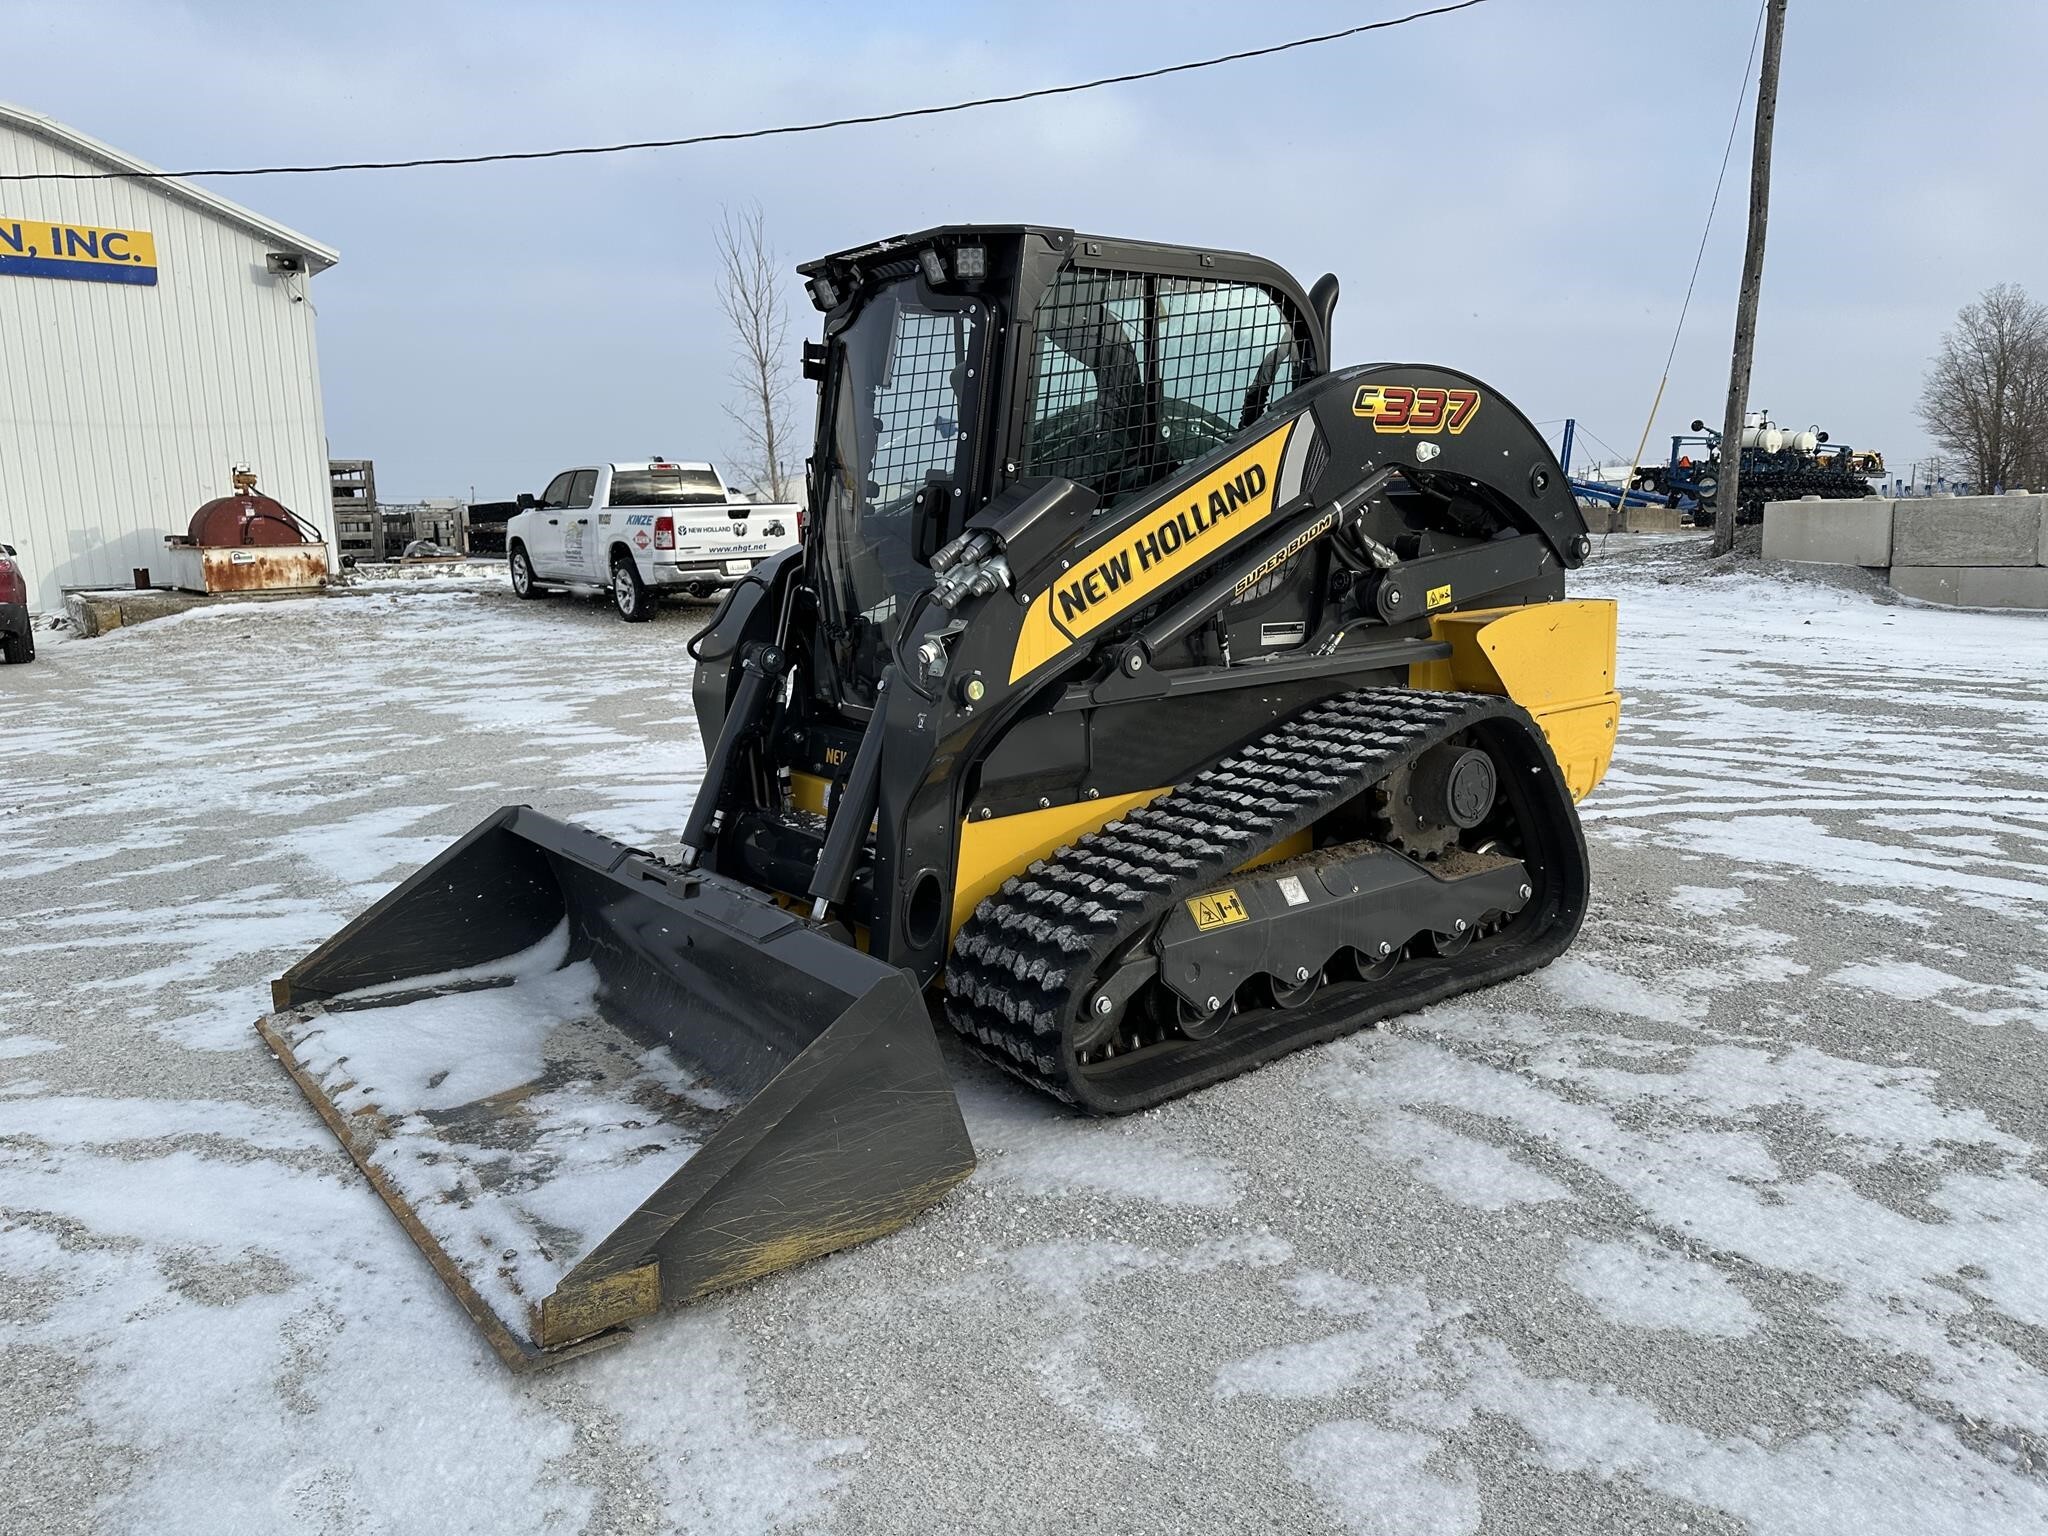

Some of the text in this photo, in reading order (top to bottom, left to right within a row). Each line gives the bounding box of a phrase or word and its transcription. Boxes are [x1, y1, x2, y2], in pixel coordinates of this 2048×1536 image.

[51, 227, 142, 262] INC.
[1353, 385, 1480, 434] C337
[626, 514, 654, 526] KINZE
[688, 525, 732, 534] NEW HOLLAND
[708, 543, 767, 554] www.nhgt.net
[1058, 463, 1268, 623] NEW HOLLAND
[1235, 514, 1333, 597] SUPER BOOM
